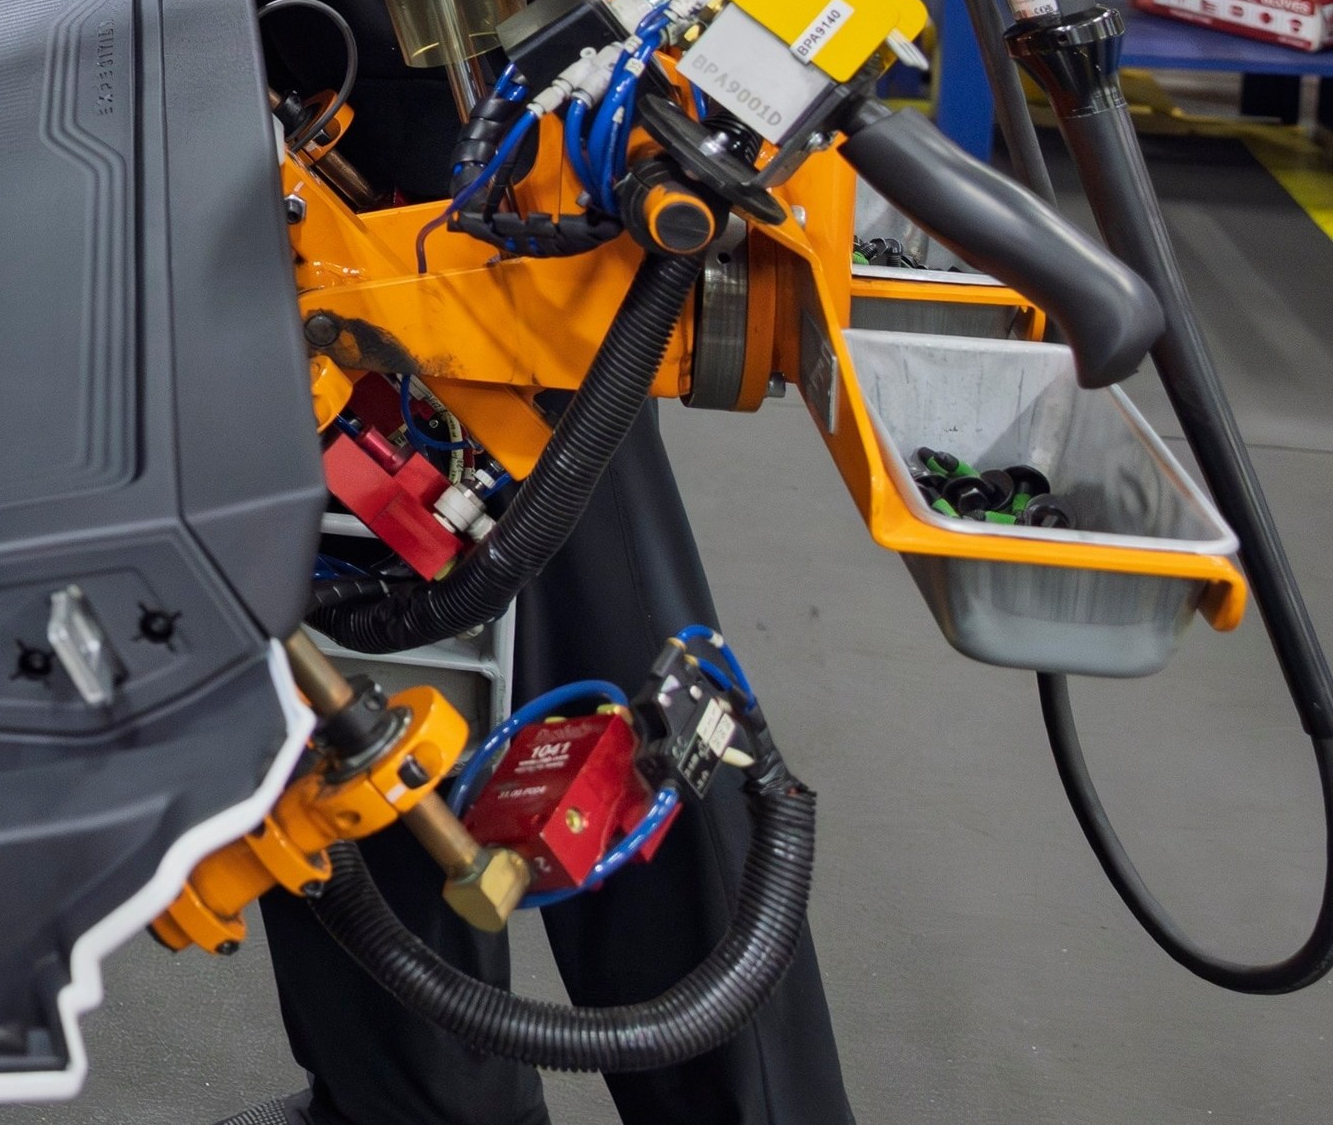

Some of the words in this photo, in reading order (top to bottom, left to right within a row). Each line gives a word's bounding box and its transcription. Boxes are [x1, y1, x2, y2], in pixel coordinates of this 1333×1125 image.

[797, 9, 841, 57] BPA9140
[691, 54, 783, 127] BPA9001D
[530, 742, 572, 759] 1041
